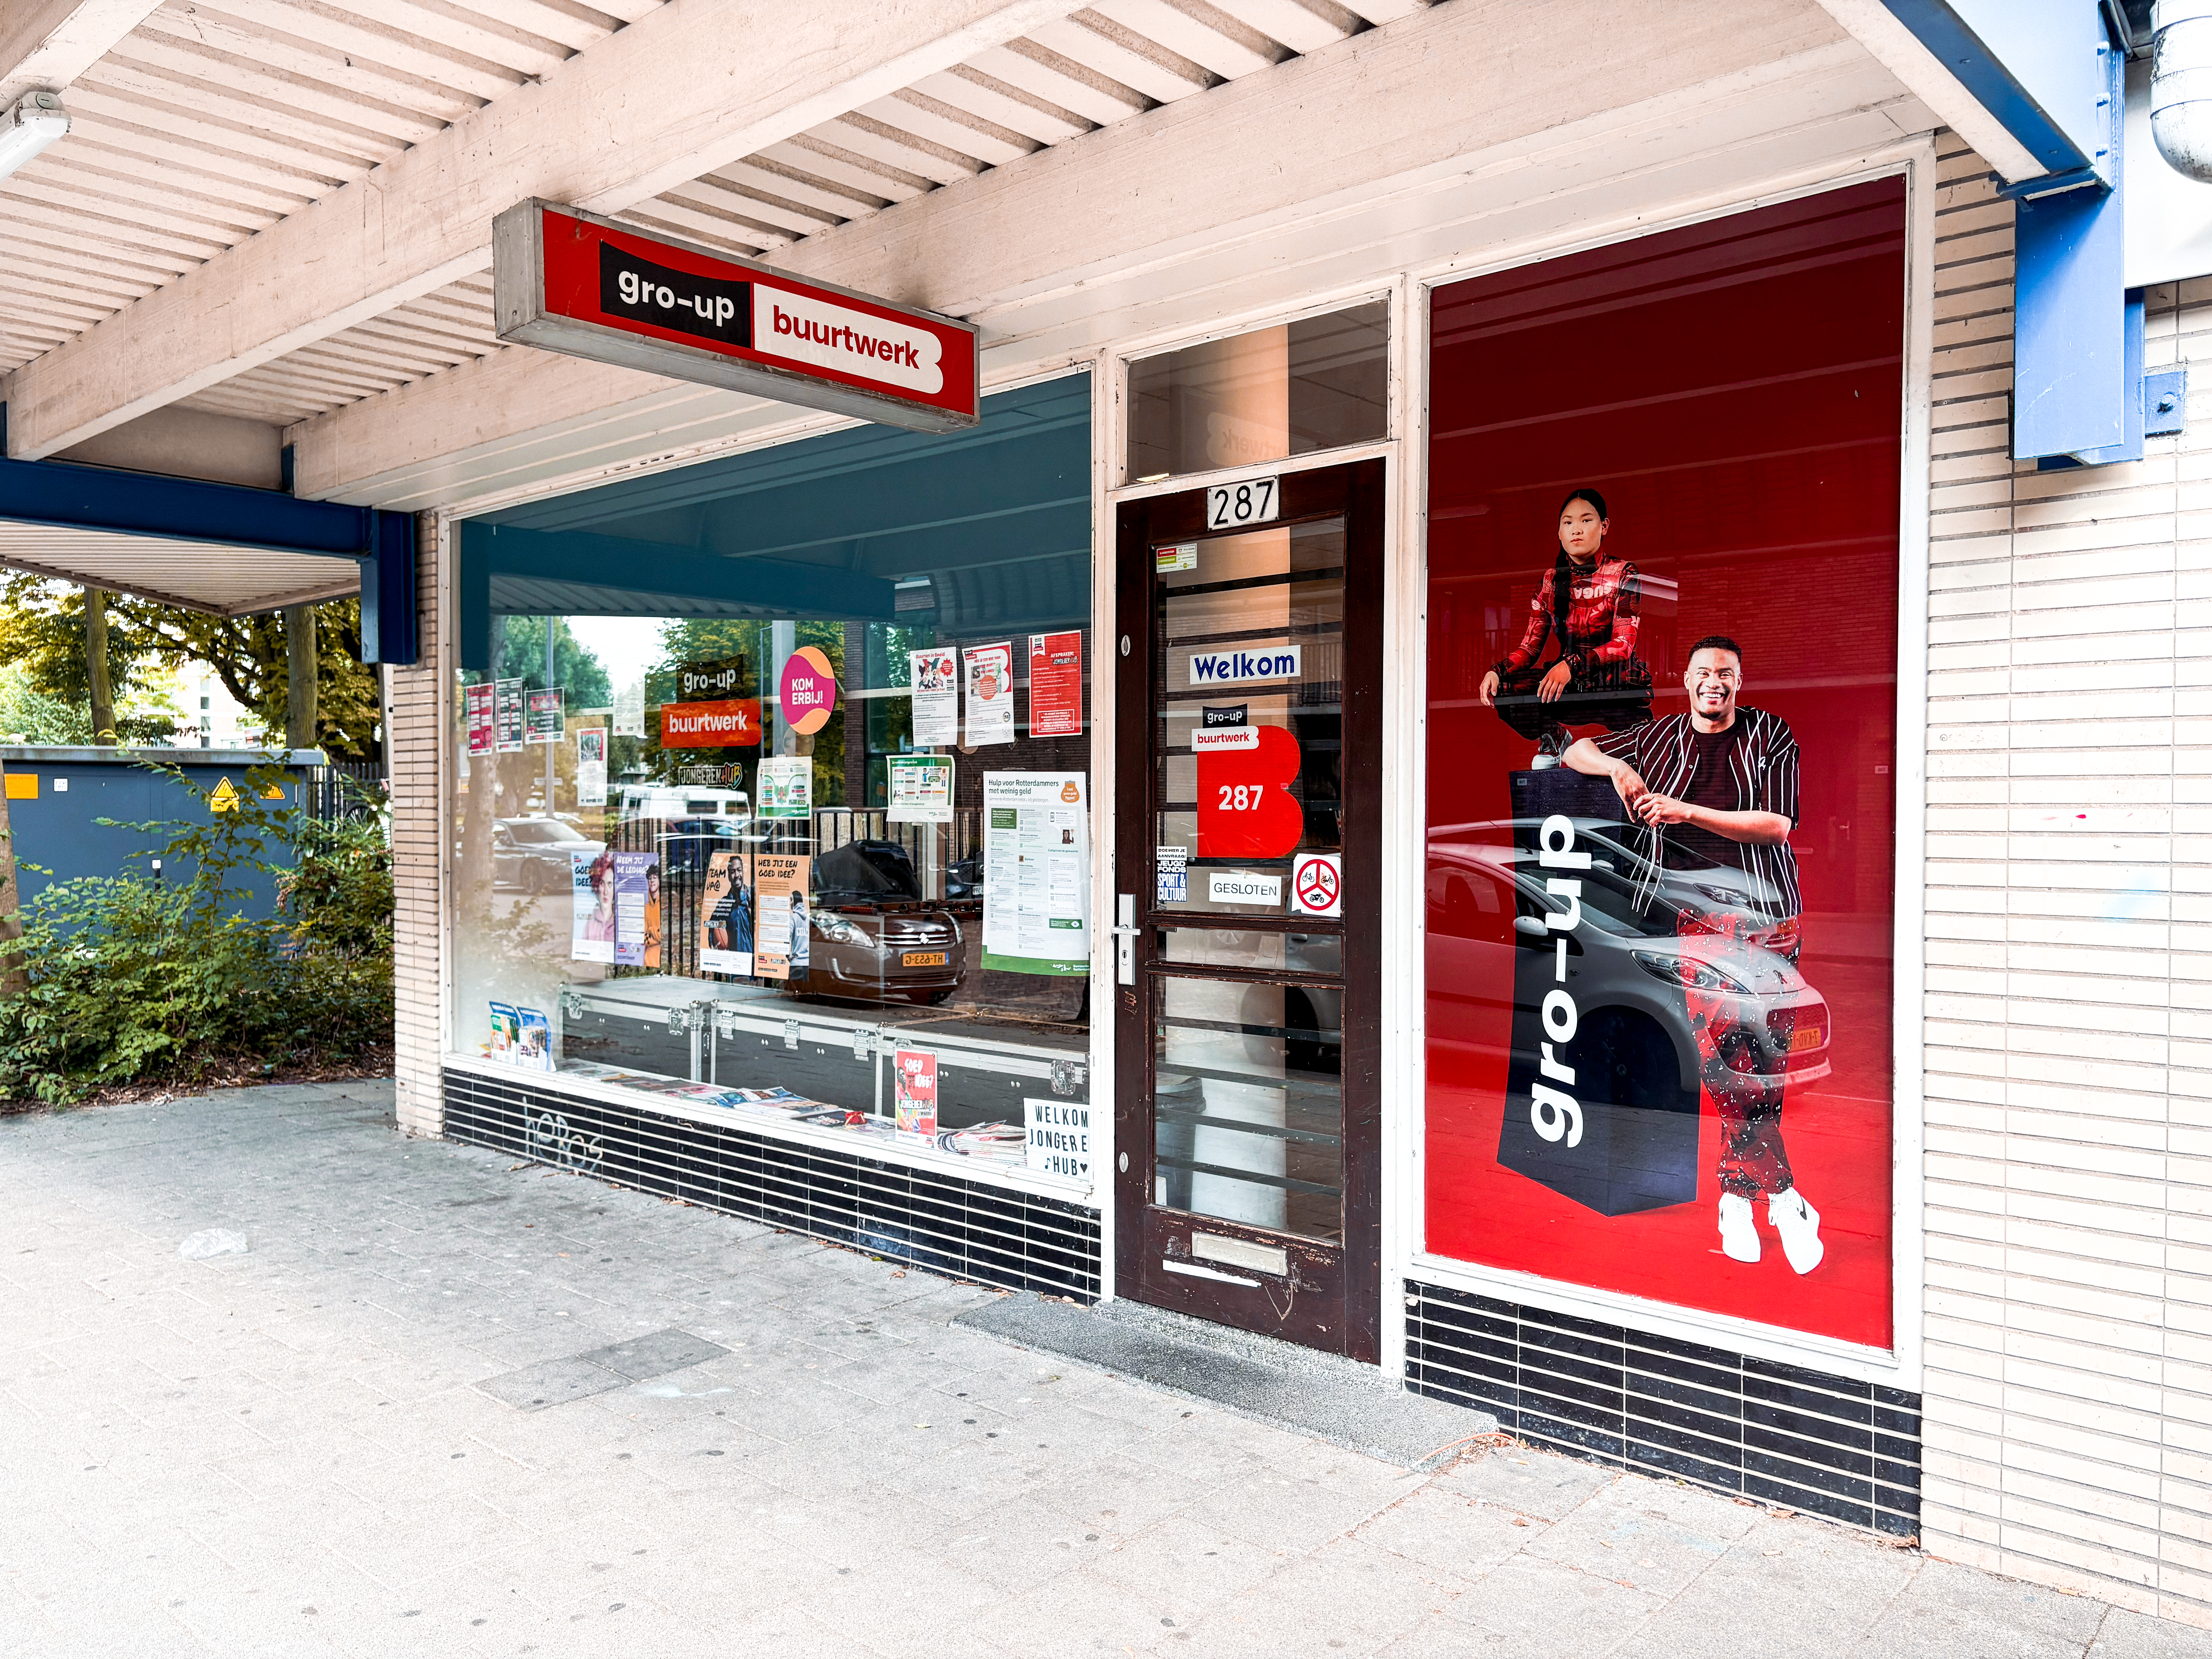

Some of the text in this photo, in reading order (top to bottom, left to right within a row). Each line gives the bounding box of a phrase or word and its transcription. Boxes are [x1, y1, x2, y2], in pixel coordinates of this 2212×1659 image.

[618, 270, 735, 328] gro-up
[773, 304, 920, 370] buurtwerk
[1214, 480, 1274, 526] 287
[1194, 653, 1295, 682] Welkom
[684, 669, 736, 693] gro-up
[791, 677, 814, 691] KOM
[791, 690, 823, 706] ERBIJ!
[669, 710, 747, 734] buurtwerk
[1207, 710, 1243, 723] gro-up
[1197, 732, 1250, 744] buurtwerk
[681, 764, 741, 787] JONGERENHUB
[1218, 785, 1264, 810] 287
[616, 855, 633, 864] NEEM
[626, 865, 649, 874] LEIDING?
[708, 868, 726, 878] TEAM
[778, 869, 795, 878] IDEE?
[706, 880, 721, 891] UP@
[1158, 873, 1186, 888] SPORT &
[1158, 887, 1187, 902] CULTUUR
[1214, 882, 1277, 896] GESLOTEN
[1530, 814, 1592, 1148] gro-up
[904, 1058, 923, 1073] GOED
[915, 1073, 934, 1089] IDEE?
[1035, 1105, 1088, 1128] WELKOM
[1030, 1128, 1088, 1152] JONGERE
[1053, 1156, 1077, 1176] HUB
